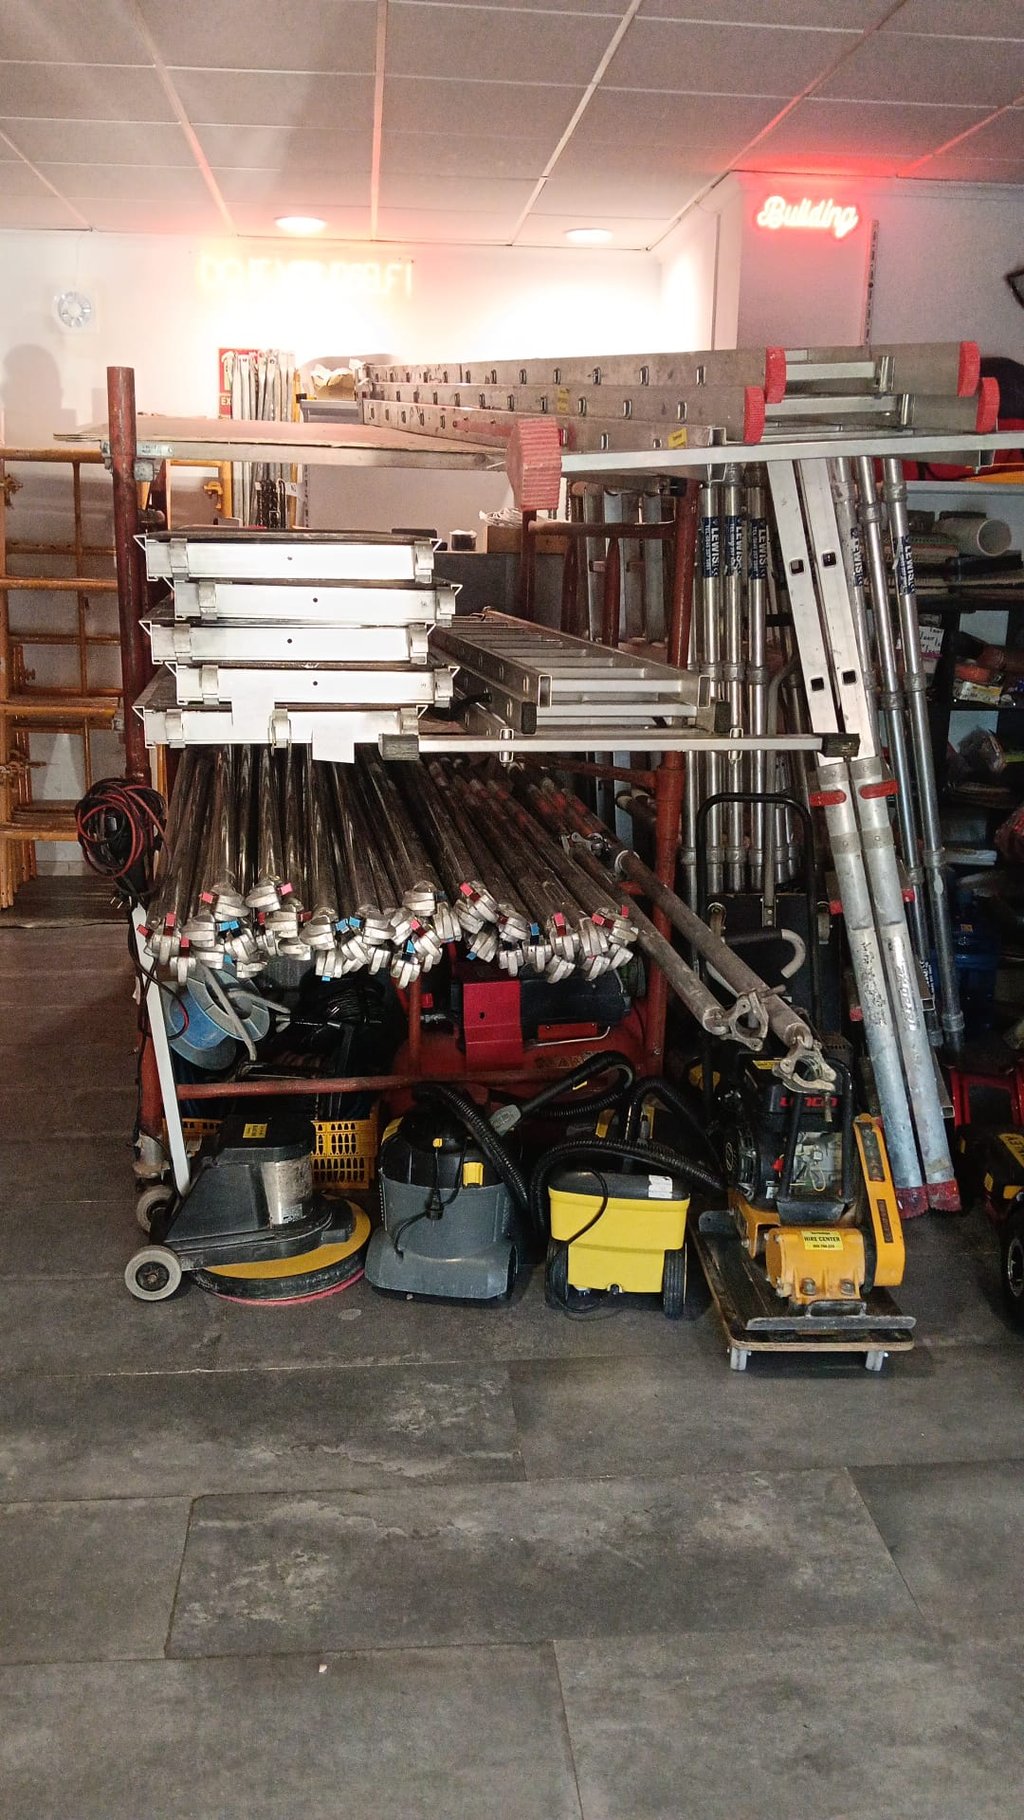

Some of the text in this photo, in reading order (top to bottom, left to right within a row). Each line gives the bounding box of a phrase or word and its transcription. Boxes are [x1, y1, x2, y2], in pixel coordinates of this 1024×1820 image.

[757, 196, 858, 238] Building
[711, 527, 719, 564] LEWIS
[759, 529, 767, 565] LEWIS
[851, 537, 862, 573] LEWIS
[905, 545, 914, 580] LEWIS
